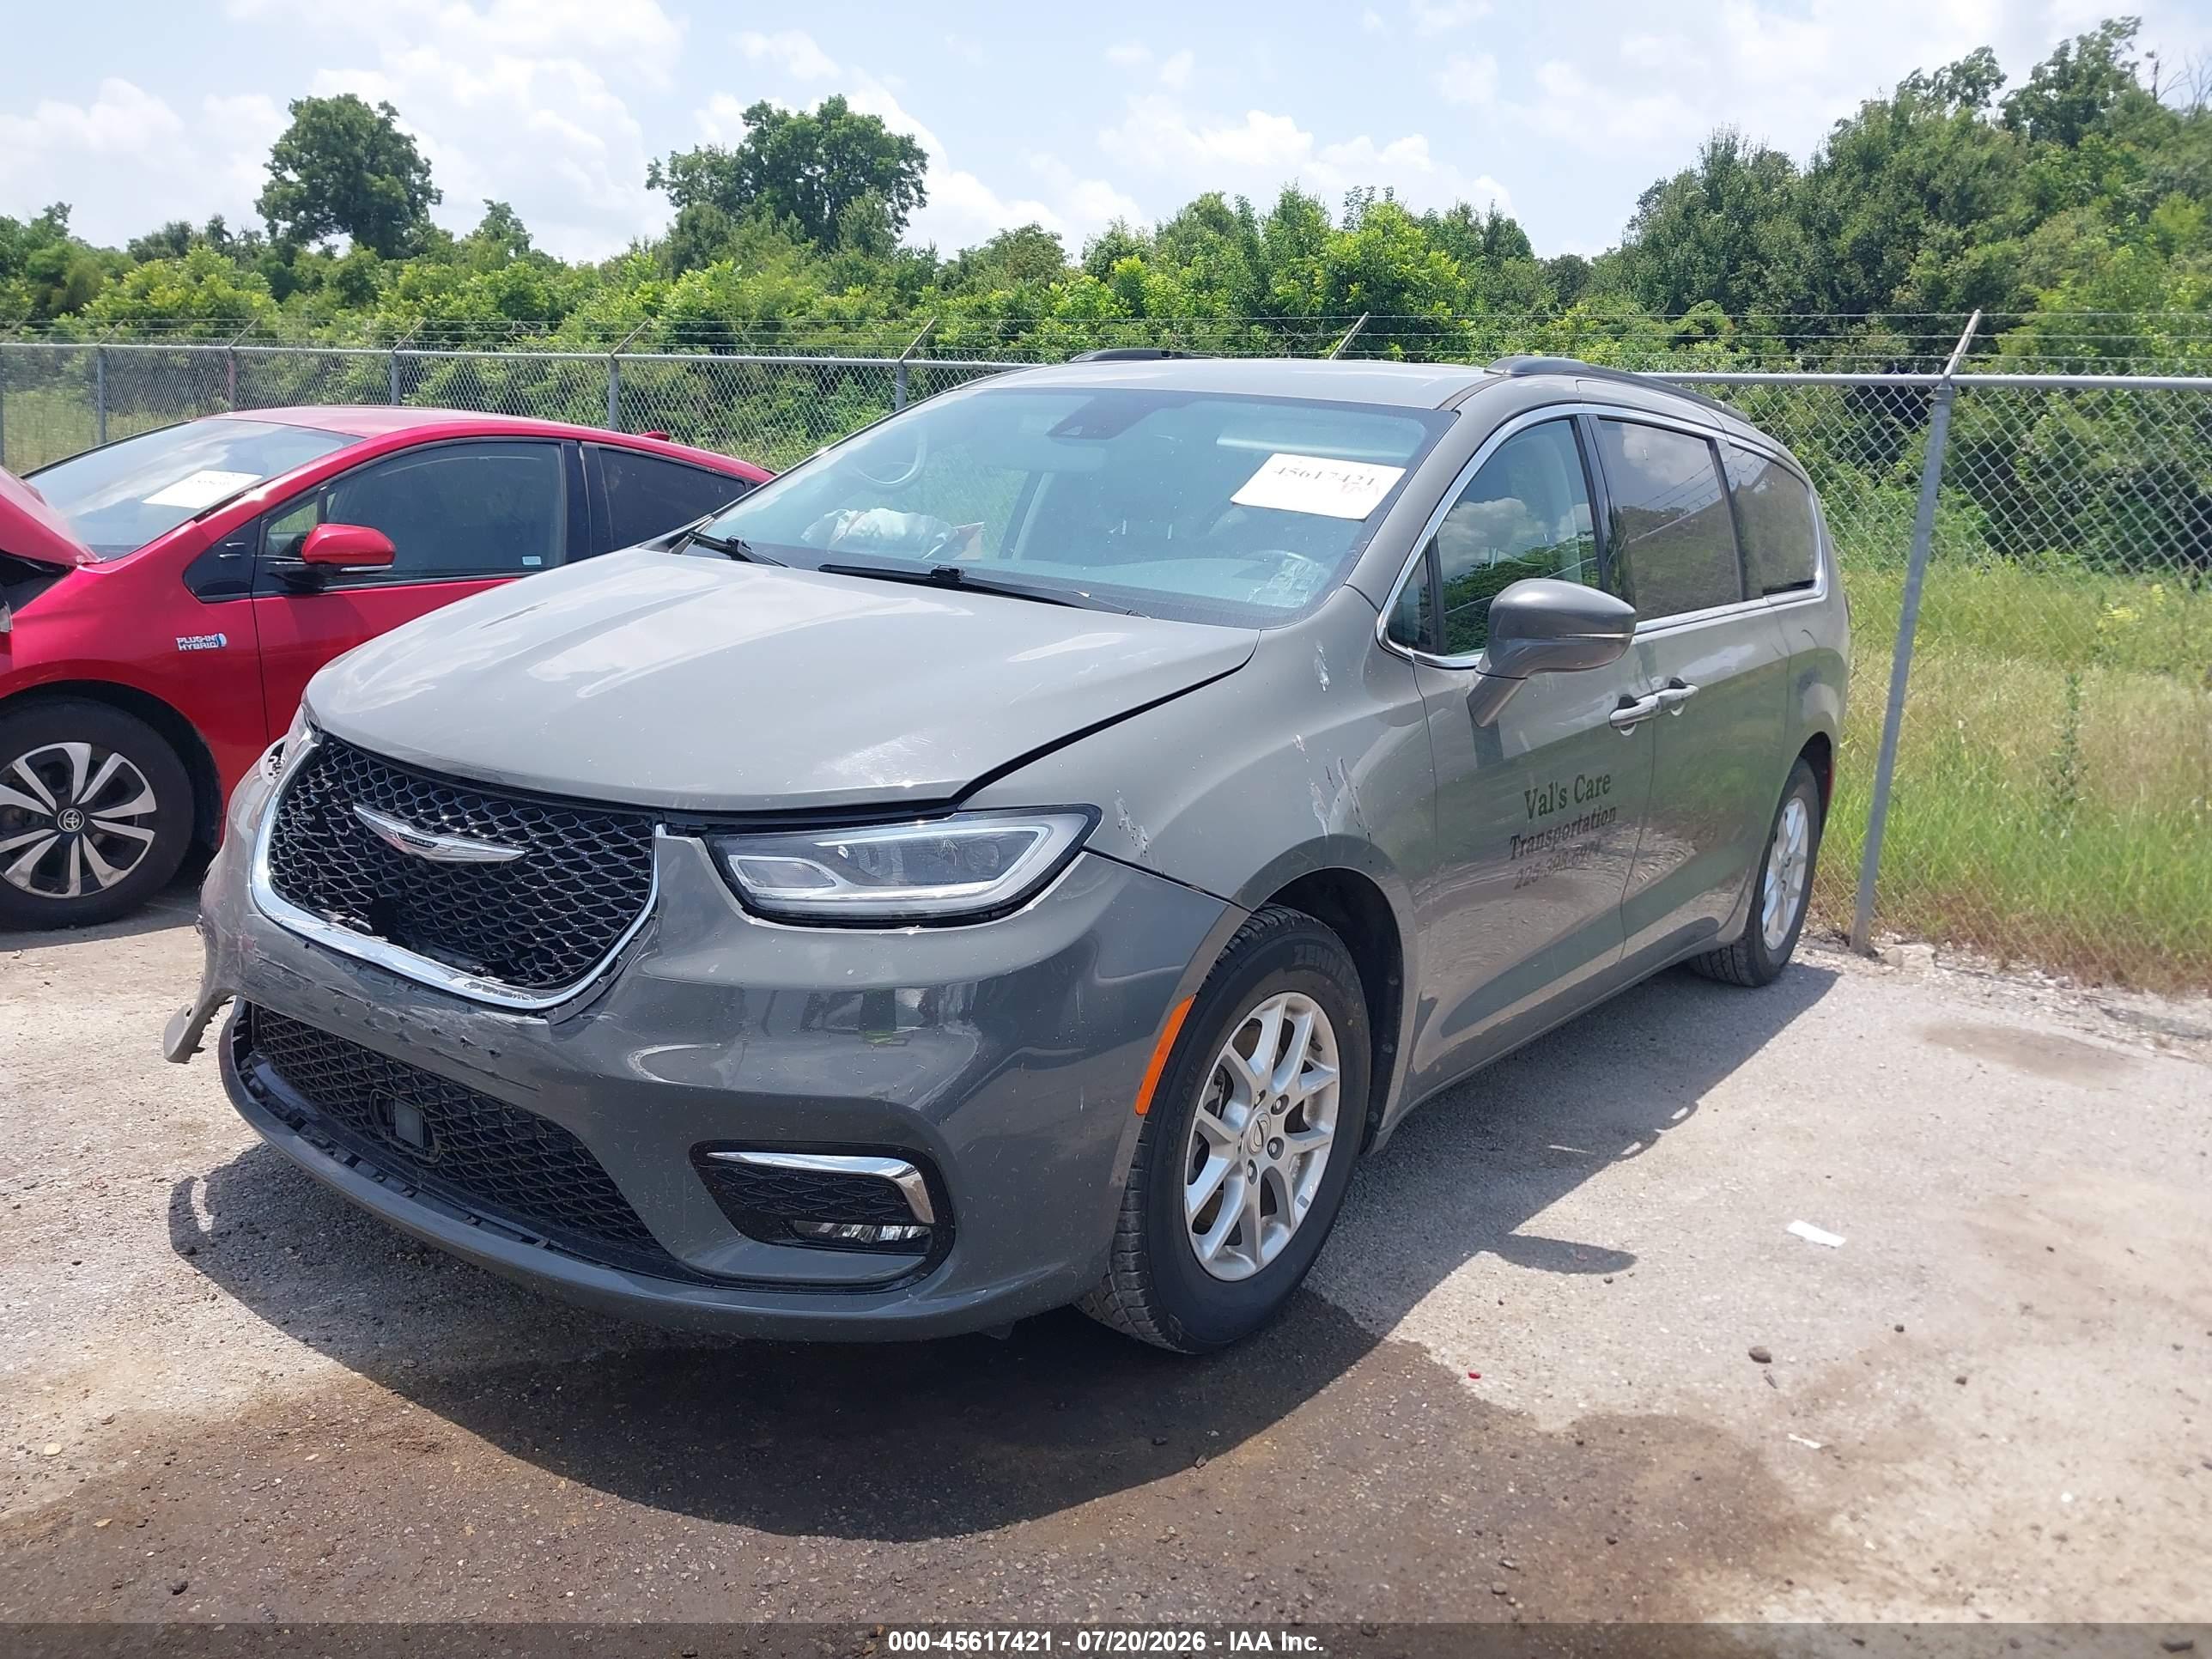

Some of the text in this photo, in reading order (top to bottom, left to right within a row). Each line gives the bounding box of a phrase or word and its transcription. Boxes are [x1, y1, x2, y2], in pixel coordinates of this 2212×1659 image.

[179, 641, 219, 651] HYBRID
[1524, 775, 1611, 819] Val's Care
[400, 835, 434, 848] CHRYSLER
[1510, 805, 1617, 860] Transportation
